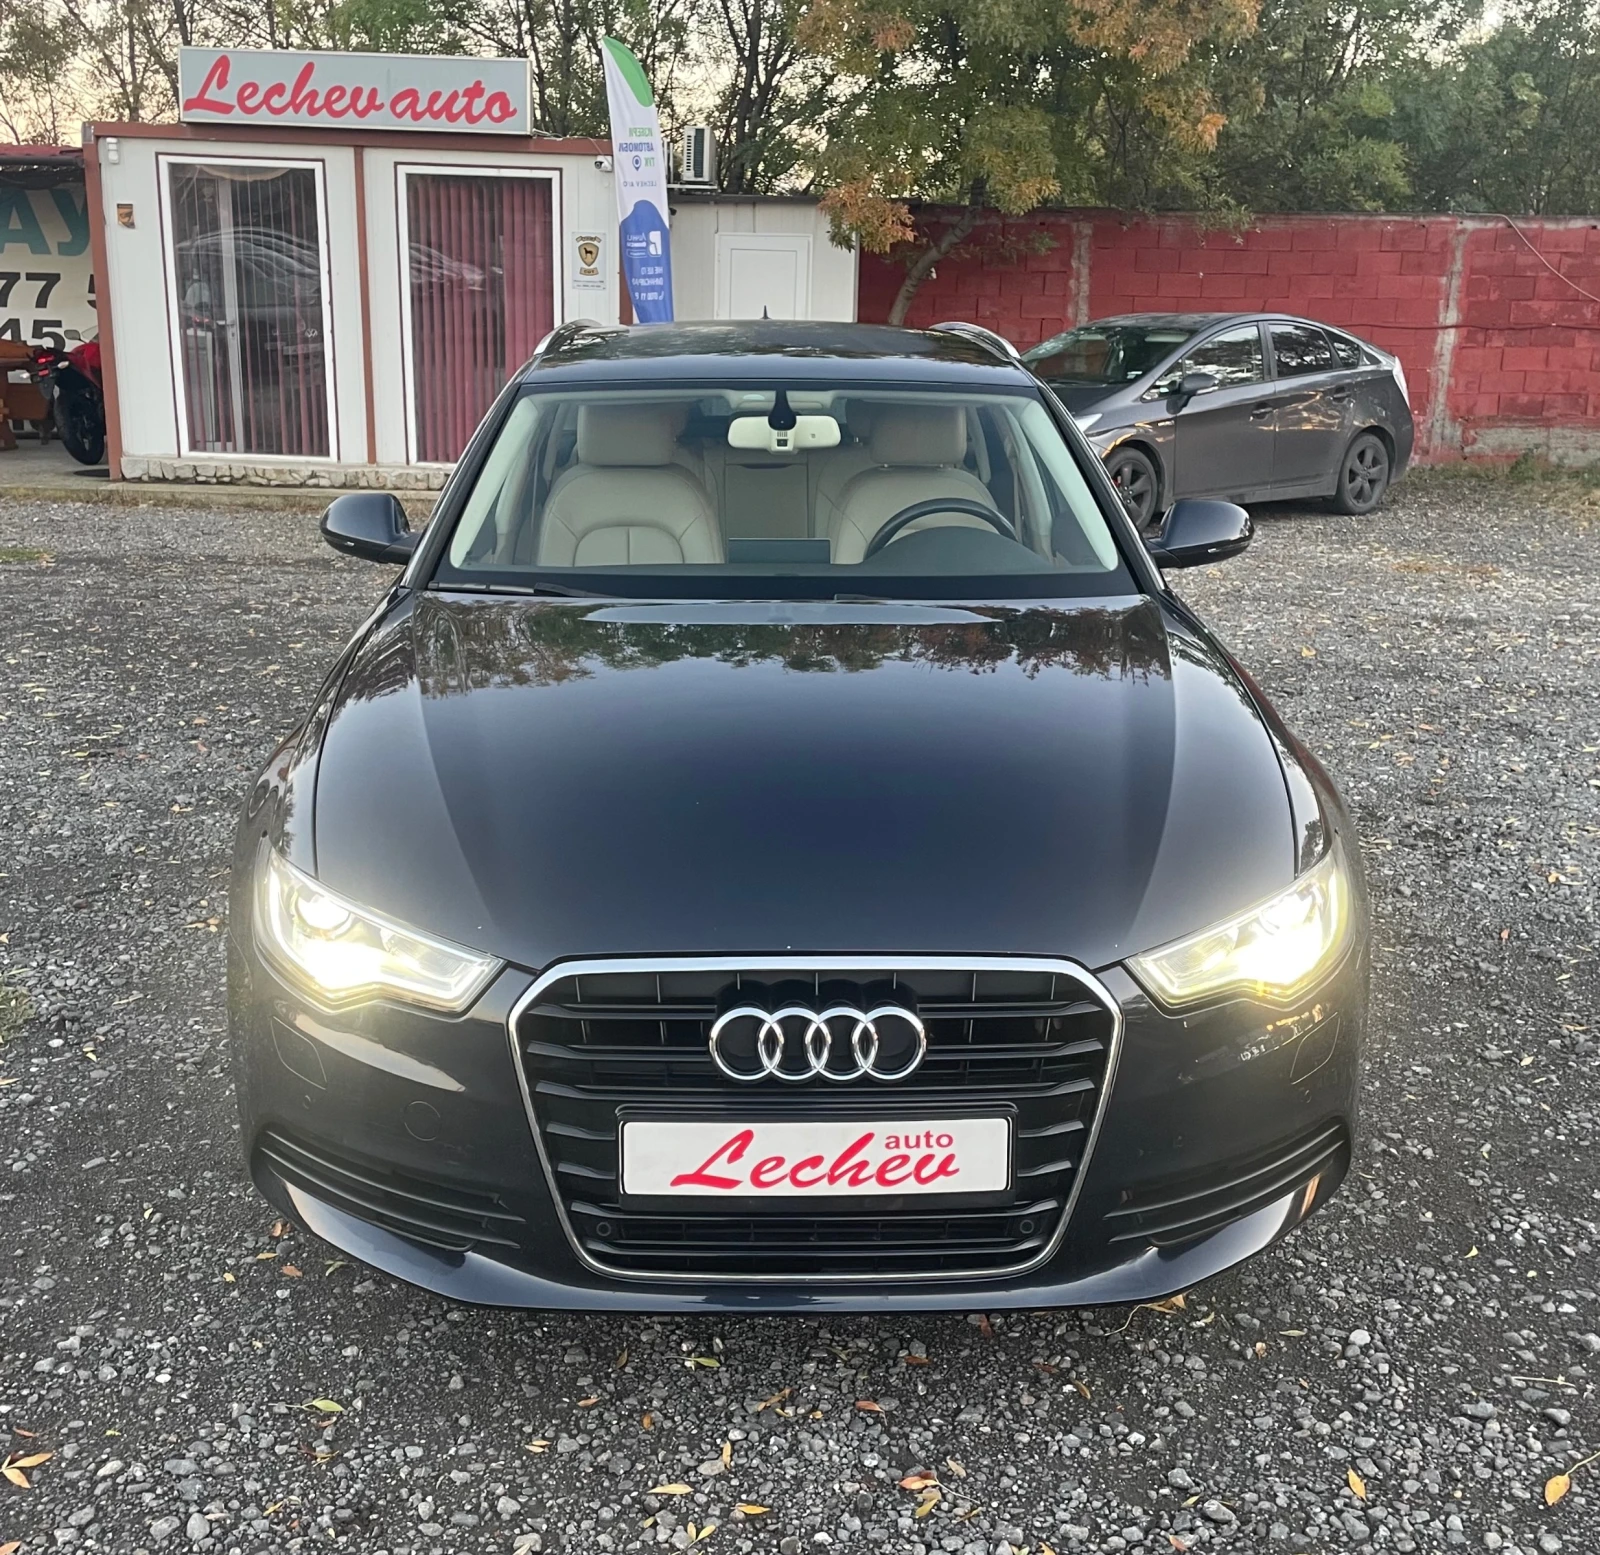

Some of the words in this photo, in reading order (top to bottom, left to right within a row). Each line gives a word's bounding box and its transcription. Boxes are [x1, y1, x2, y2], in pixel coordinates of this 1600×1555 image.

[183, 54, 384, 118] Lechev
[389, 80, 517, 124] auto
[669, 1129, 960, 1189] Lechev
[884, 1130, 954, 1150] auto
